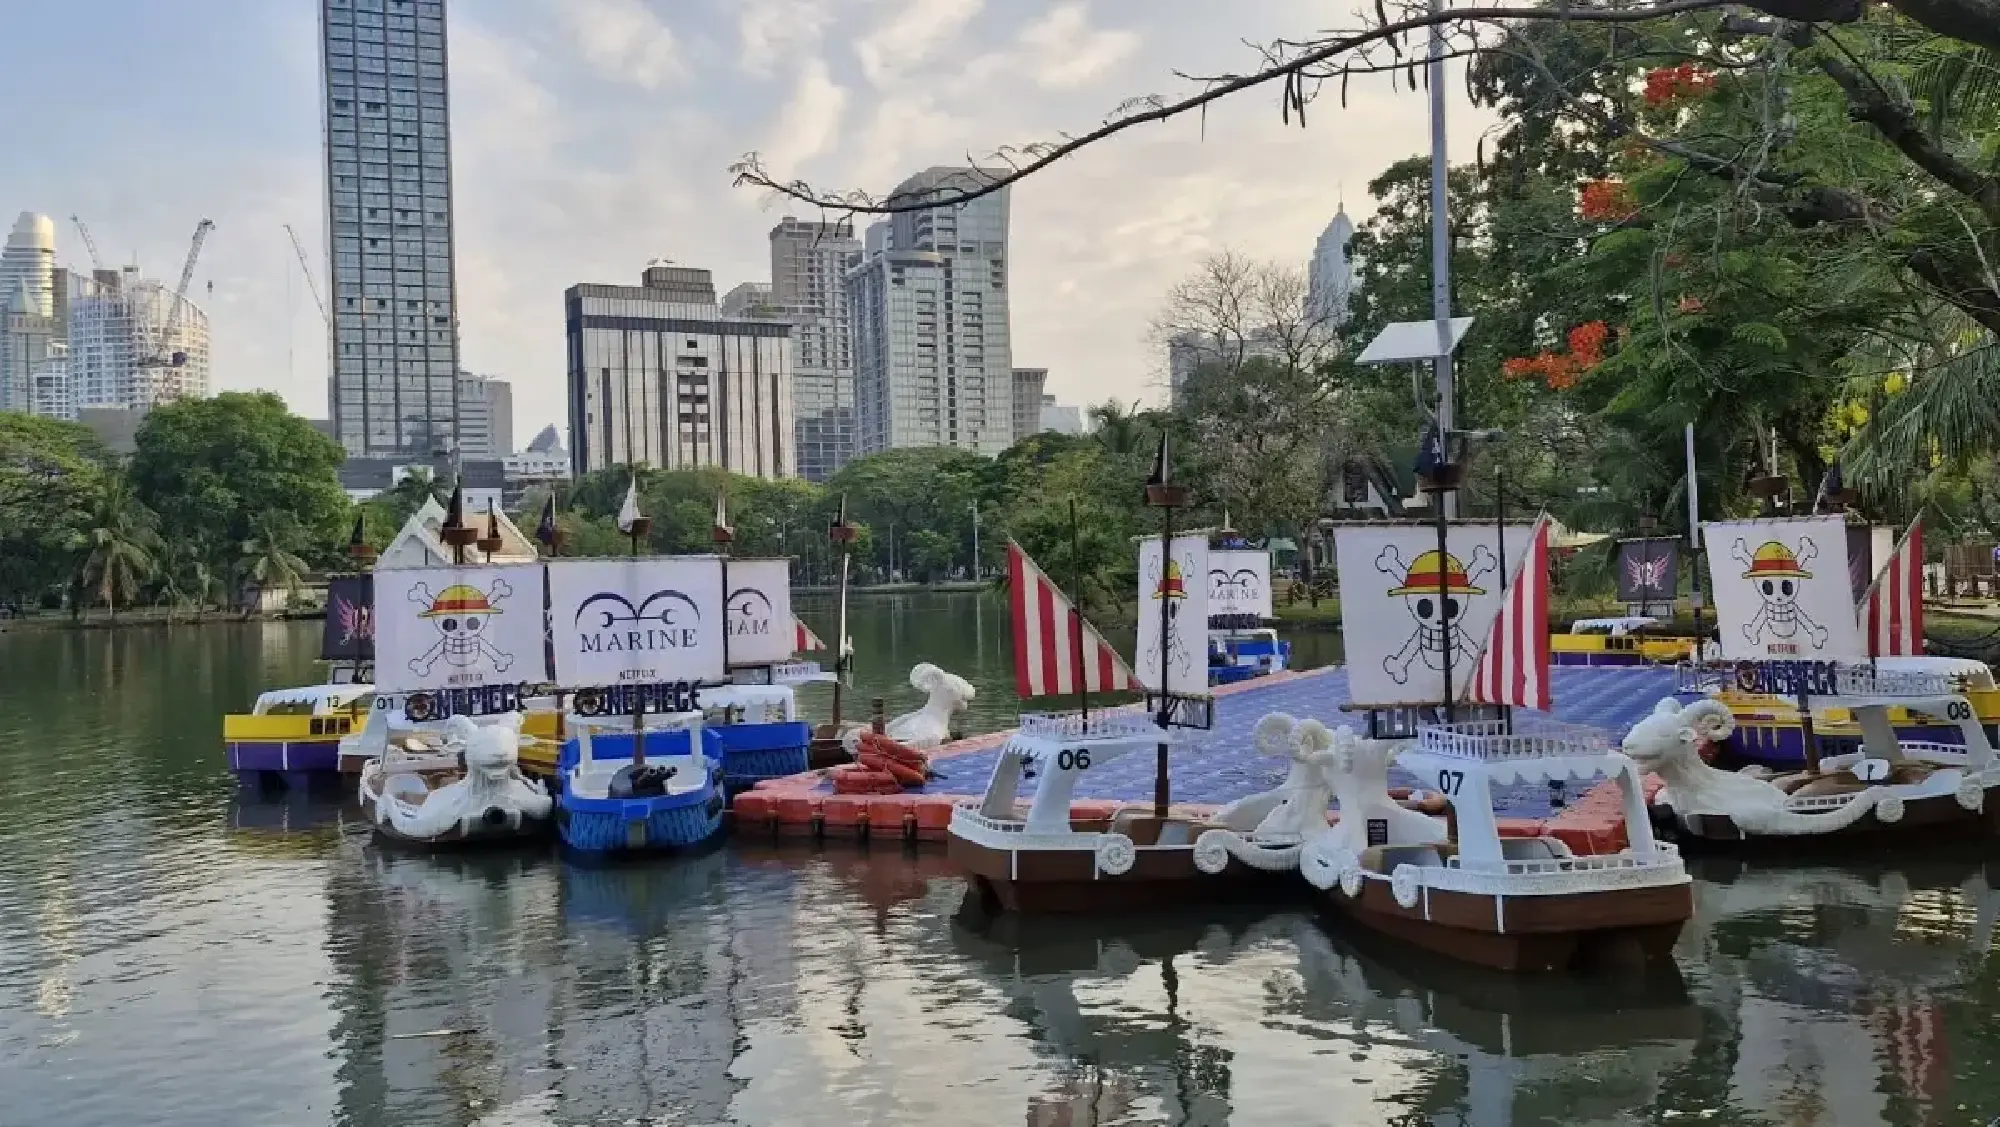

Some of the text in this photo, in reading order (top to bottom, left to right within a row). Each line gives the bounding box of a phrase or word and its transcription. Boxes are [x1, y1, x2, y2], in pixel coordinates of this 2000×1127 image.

[580, 629, 698, 653] MARINE
[619, 669, 656, 680] NETFLIX
[377, 697, 394, 710] 01
[1948, 701, 1971, 720] 08
[1057, 748, 1091, 771] 06
[1438, 769, 1464, 796] 07
